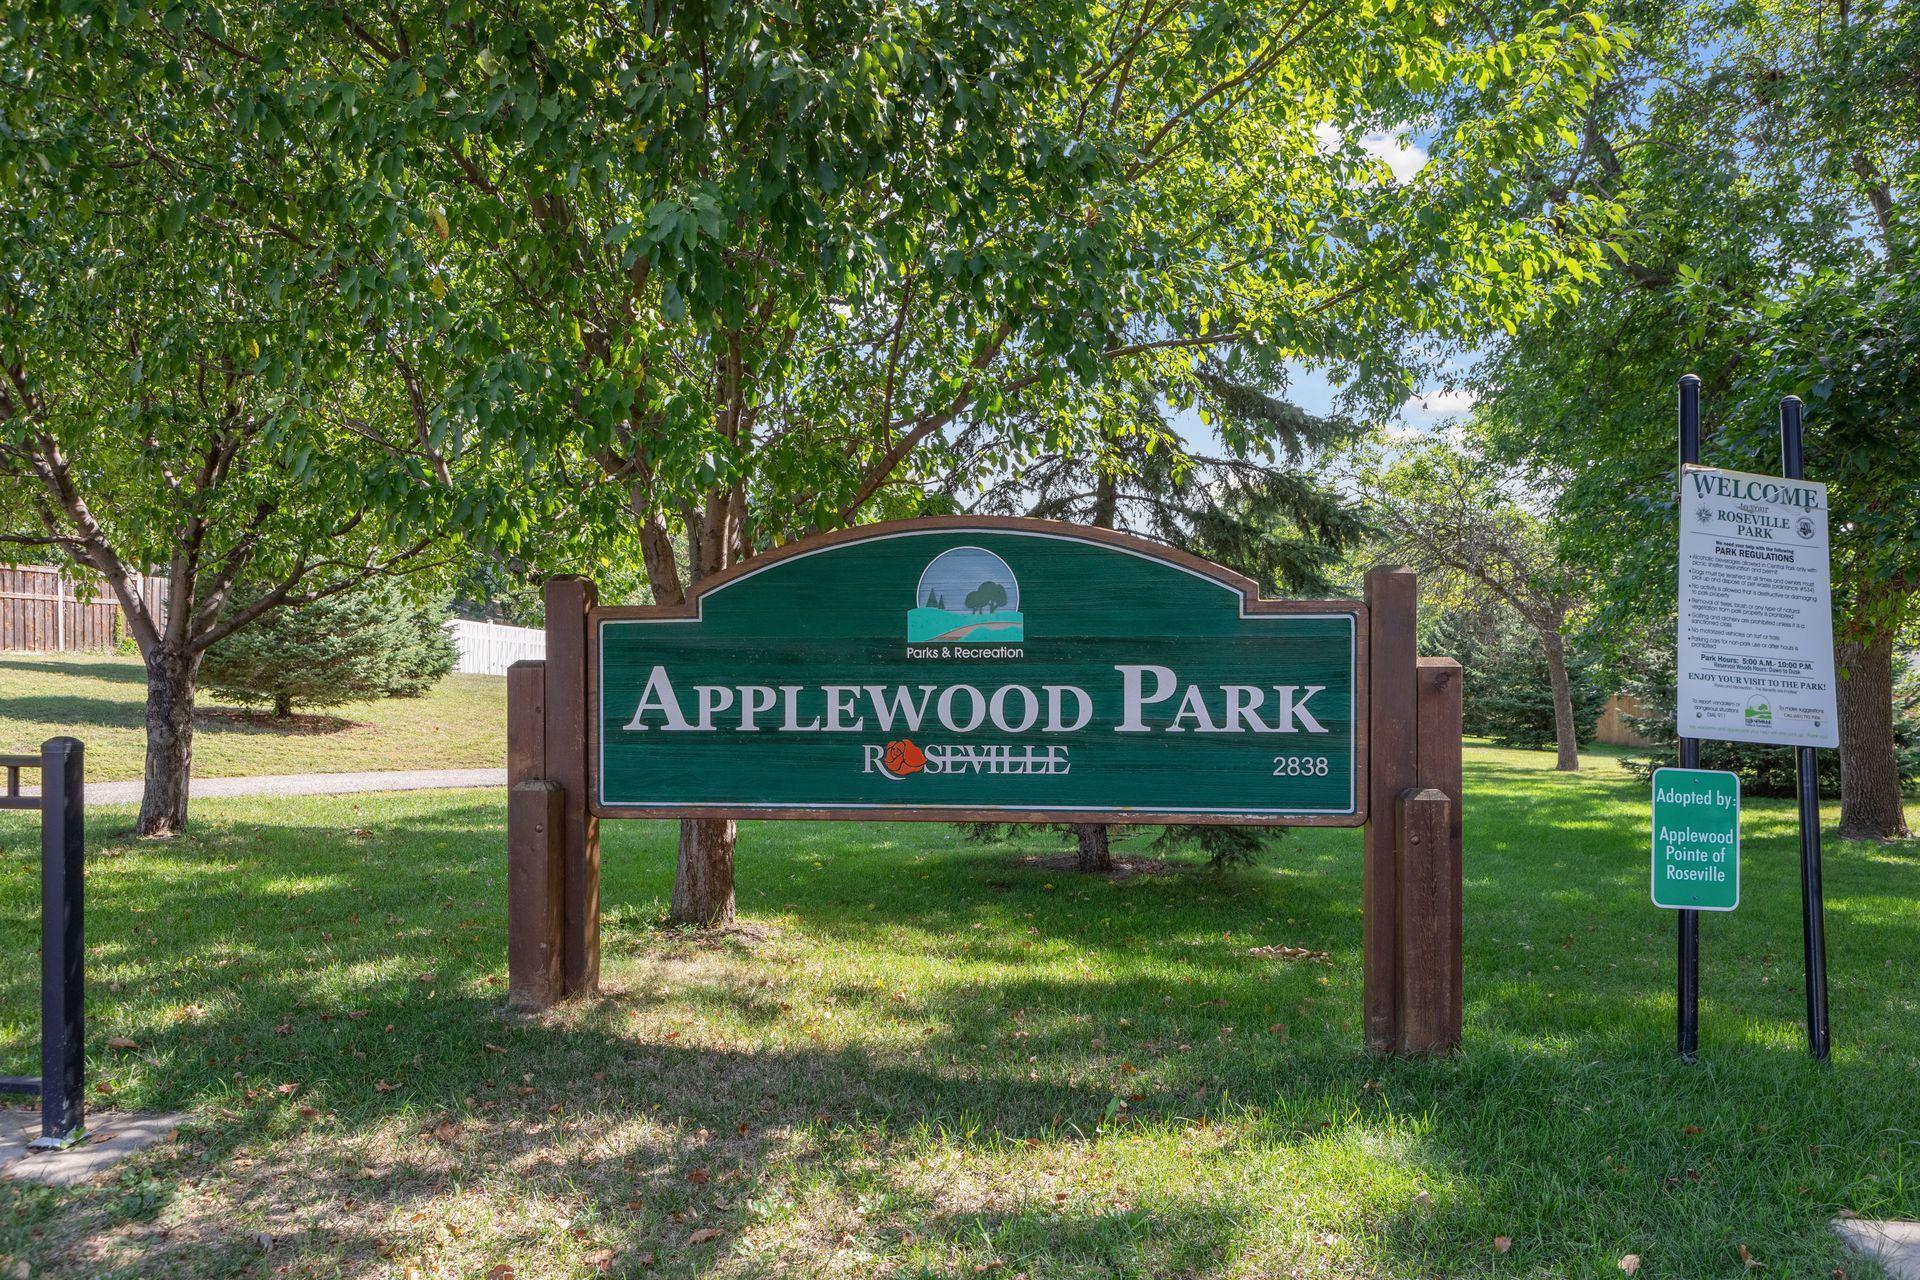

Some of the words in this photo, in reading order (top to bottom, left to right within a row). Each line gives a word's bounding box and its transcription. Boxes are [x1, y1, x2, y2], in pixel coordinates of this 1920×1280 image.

[1691, 473, 1819, 508] WELCOME
[1717, 509, 1791, 530] ROSEVILLE
[1737, 525, 1774, 539] PARK
[1715, 546, 1737, 556] PARK
[1739, 549, 1794, 563] REGULATIONS
[907, 647, 939, 659] Parks
[941, 647, 951, 658] &
[954, 647, 1024, 659] Recreation
[1717, 656, 1739, 664] Hours:
[1688, 672, 1716, 682] ENJOY
[1718, 675, 1742, 684] YOUR
[1743, 677, 1766, 686] VISIT
[1780, 680, 1799, 689] THE
[1800, 682, 1826, 691] PARK!
[623, 665, 1094, 733] APPLEWOOD
[1114, 664, 1329, 733] PARK
[1272, 756, 1329, 776] 2838
[1656, 788, 1712, 807] Adopted
[1716, 790, 1736, 809] by:
[1660, 826, 1733, 845] Applewood
[1666, 845, 1708, 862] Pointe
[1712, 847, 1726, 862] of
[1667, 864, 1726, 882] Roseville
